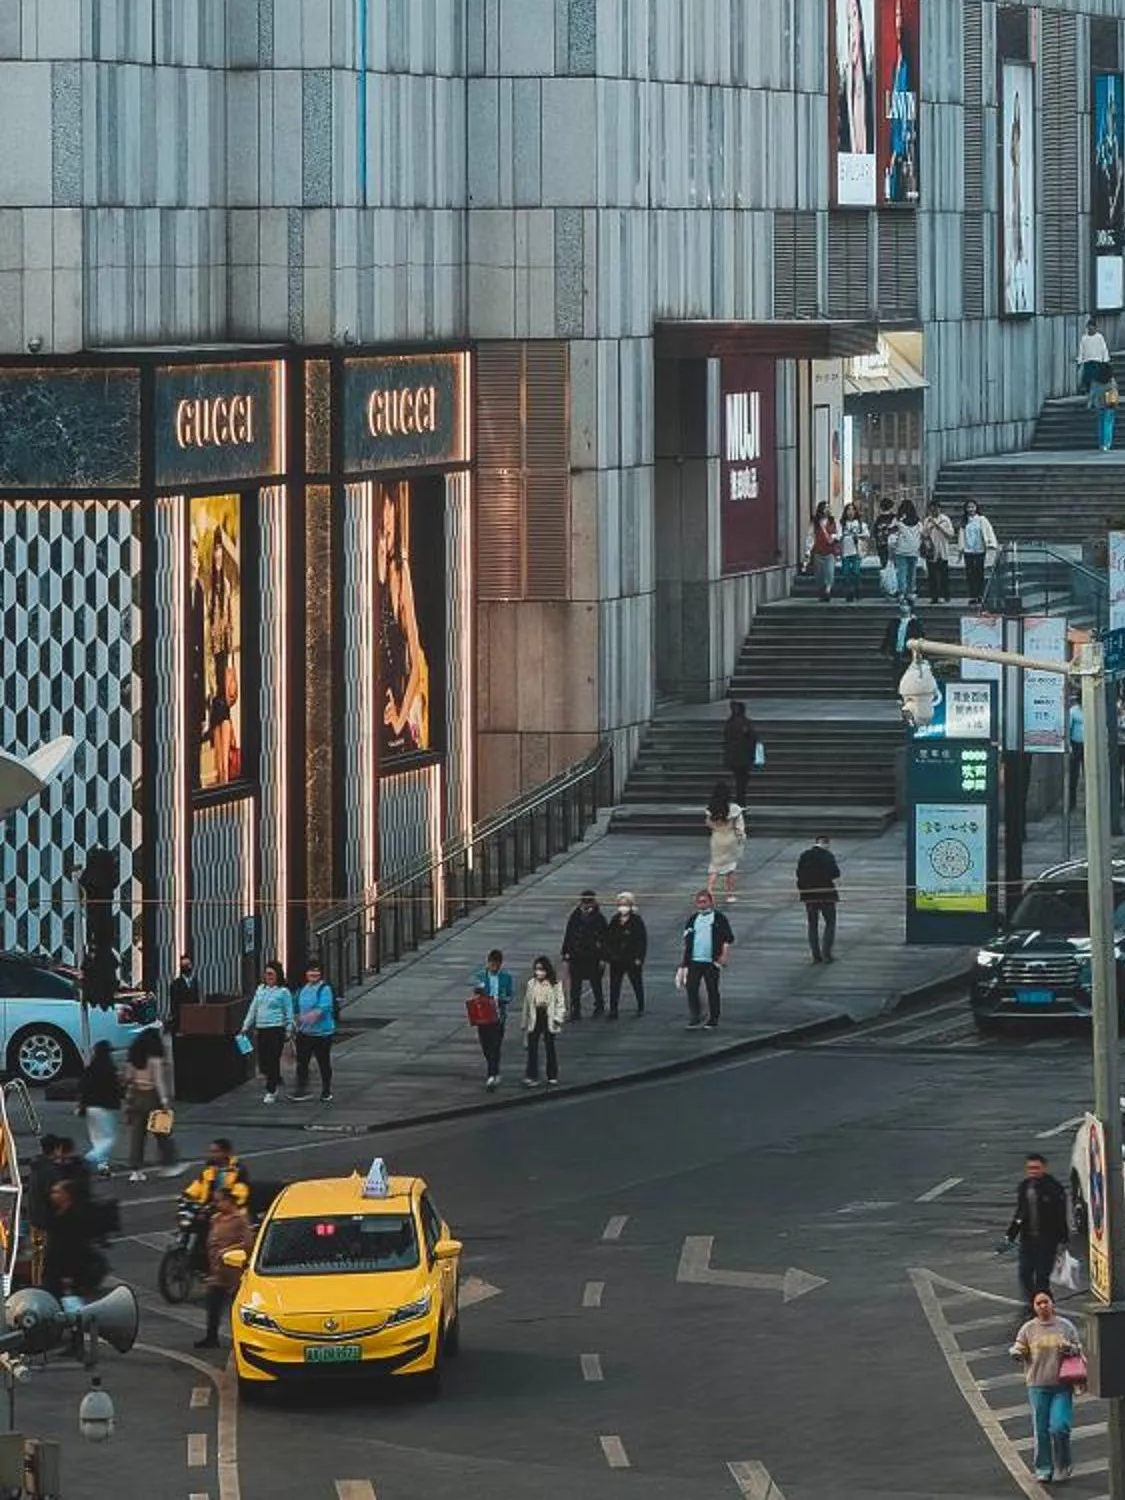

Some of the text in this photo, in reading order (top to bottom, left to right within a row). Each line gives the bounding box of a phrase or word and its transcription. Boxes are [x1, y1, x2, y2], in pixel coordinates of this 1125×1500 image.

[177, 396, 253, 449] GUCCI
[368, 386, 436, 437] GUCCI
[725, 391, 760, 461] MUJI
